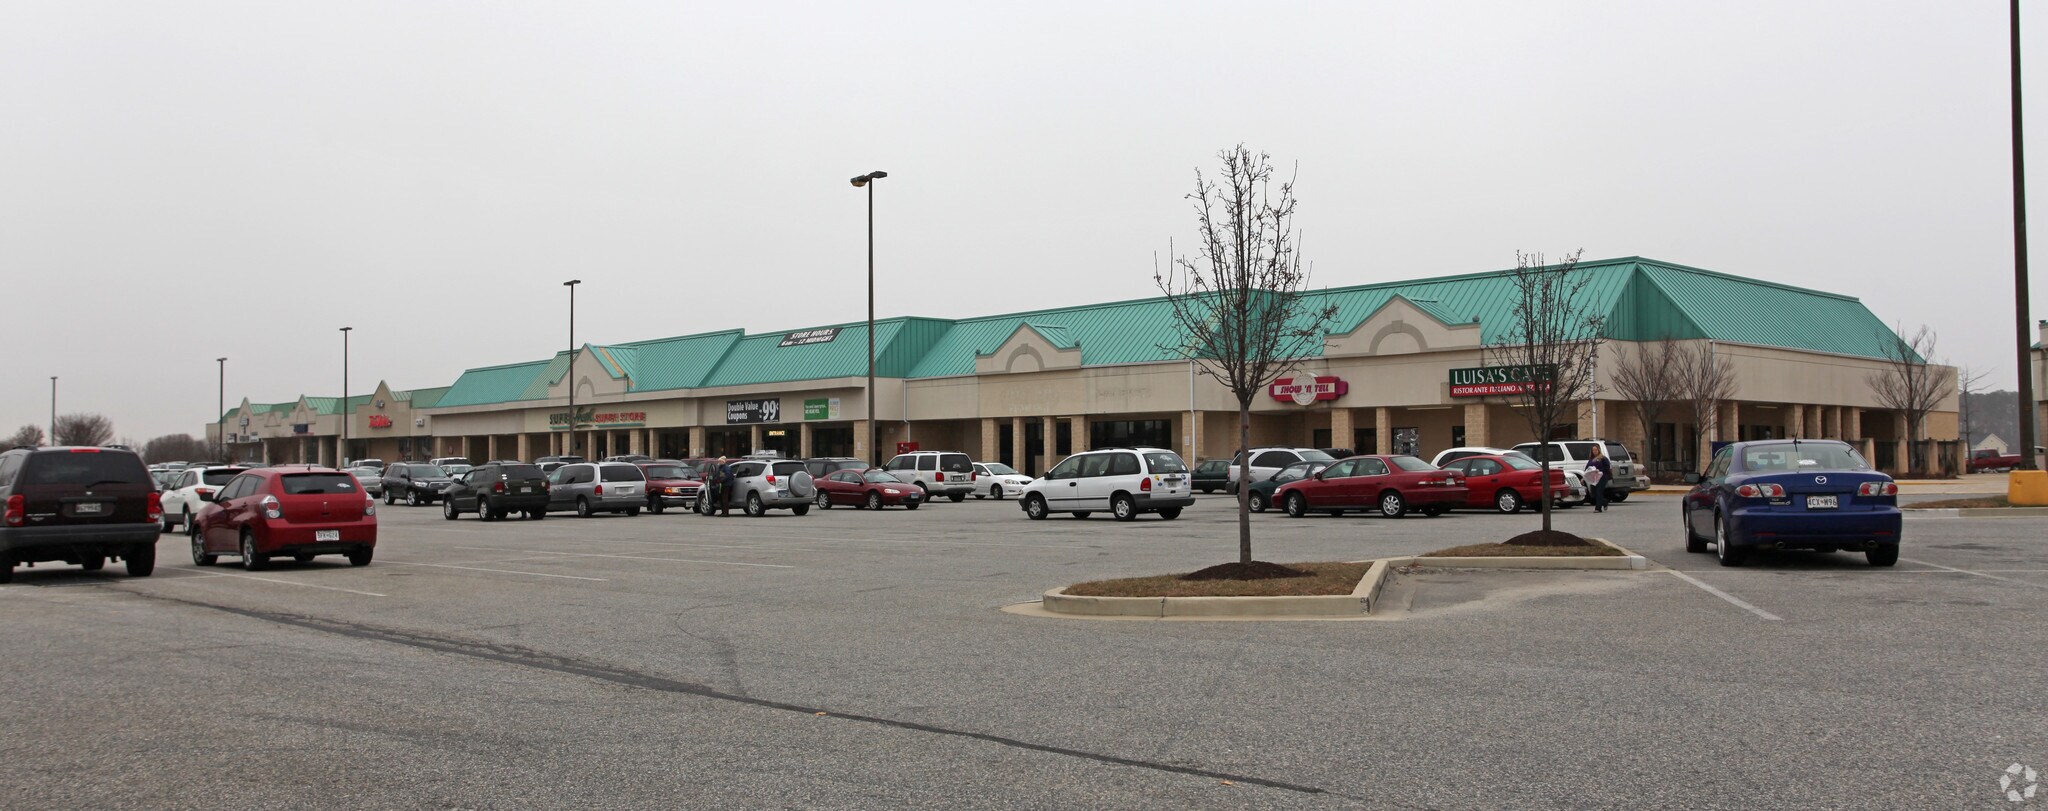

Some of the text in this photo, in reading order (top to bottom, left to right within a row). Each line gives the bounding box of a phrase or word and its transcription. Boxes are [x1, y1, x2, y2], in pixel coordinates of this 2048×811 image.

[791, 329, 834, 339] STORE HOURS
[806, 335, 833, 343] MIDNIGHT
[1454, 368, 1507, 385] LUISA'S
[1280, 385, 1302, 394] SHOW
[1315, 384, 1329, 393] TELL
[1453, 386, 1488, 394] RISTORANTE
[728, 402, 744, 412] Double
[745, 402, 759, 411] Value
[620, 411, 646, 421] STORE
[728, 411, 748, 422] Coupons
